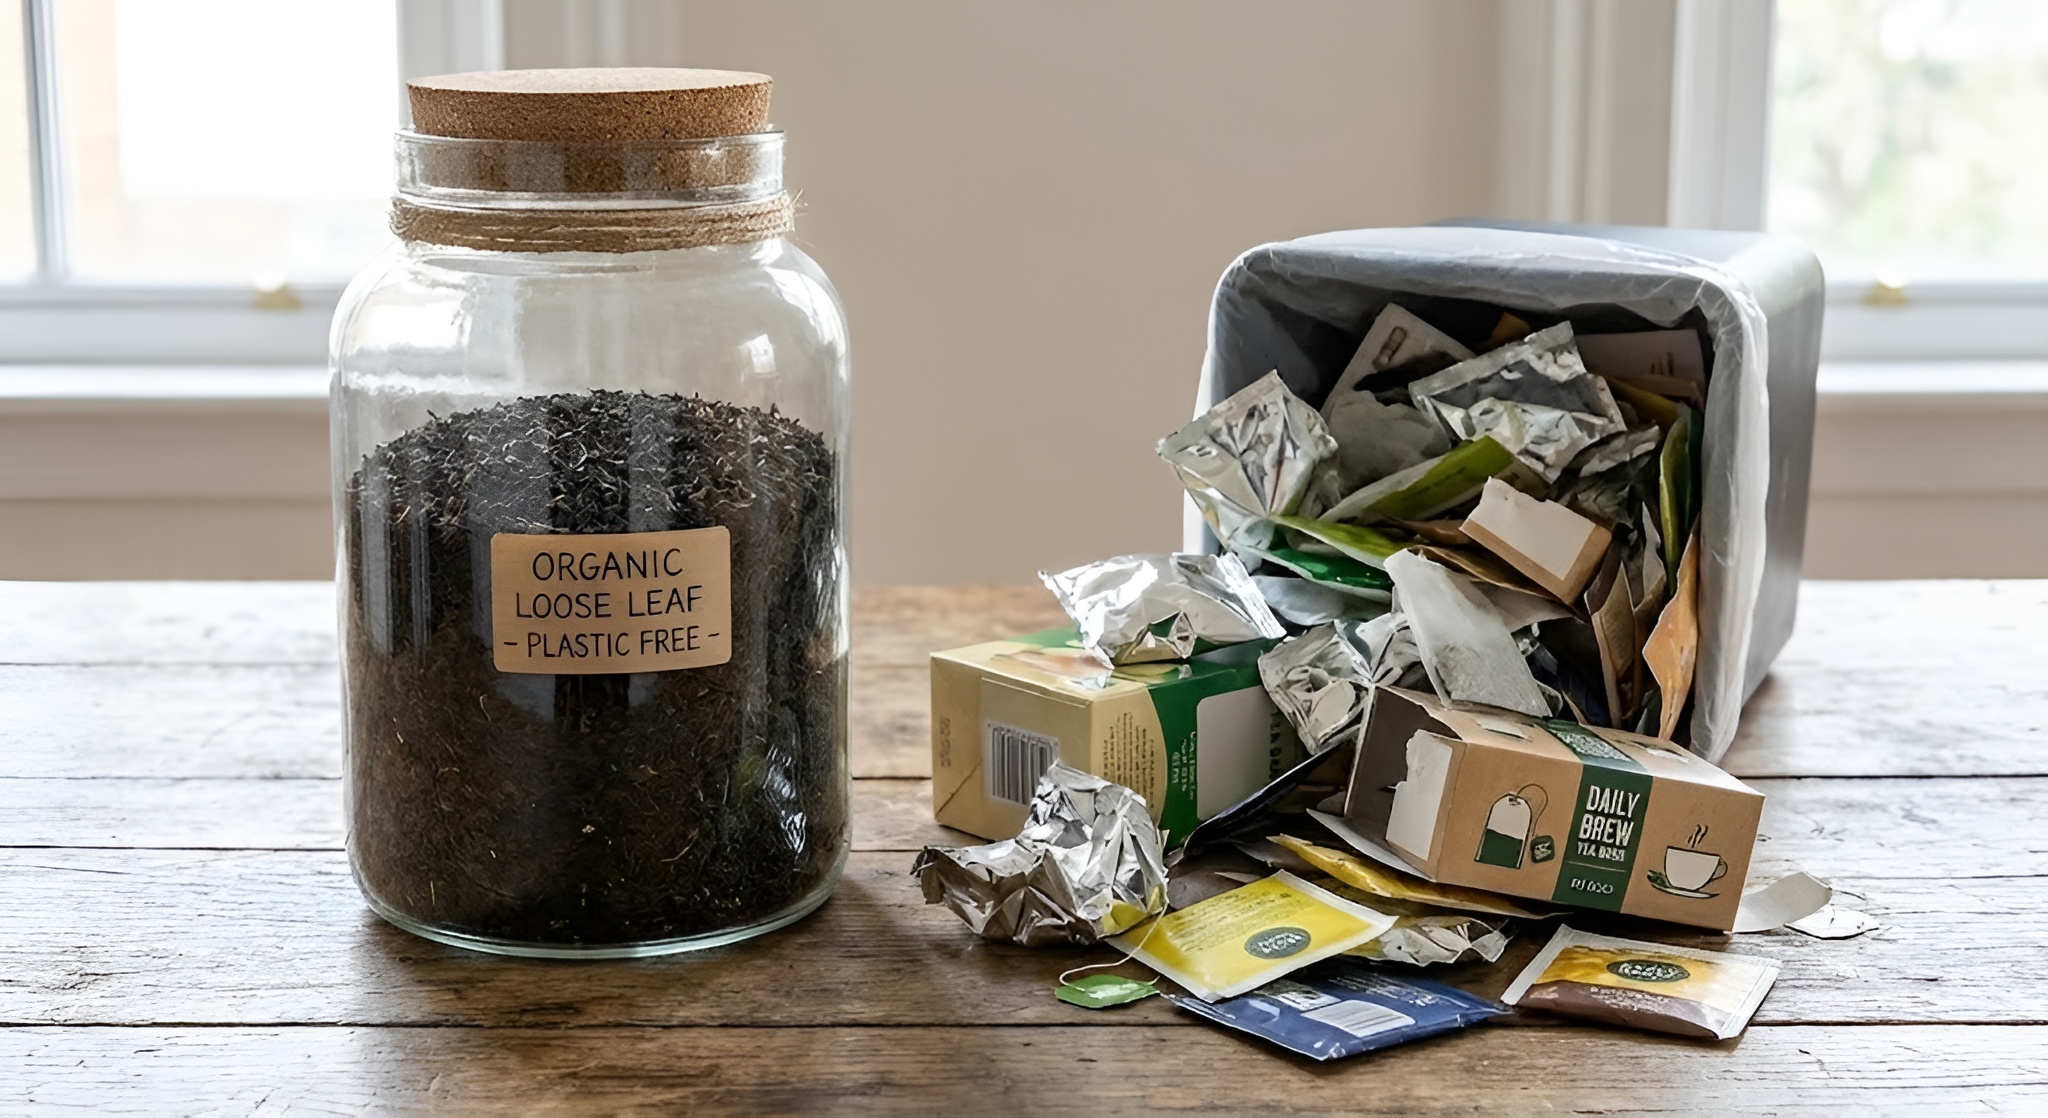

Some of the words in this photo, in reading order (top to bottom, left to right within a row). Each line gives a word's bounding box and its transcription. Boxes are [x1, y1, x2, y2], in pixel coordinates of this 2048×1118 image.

[532, 548, 683, 581] ORGANIC
[516, 592, 611, 618] LOOSE
[628, 585, 702, 617] LEAF
[527, 632, 630, 658] PLASTIC
[640, 625, 701, 655] FREE
[1585, 785, 1640, 818] DAILY
[1578, 813, 1634, 847] BREW
